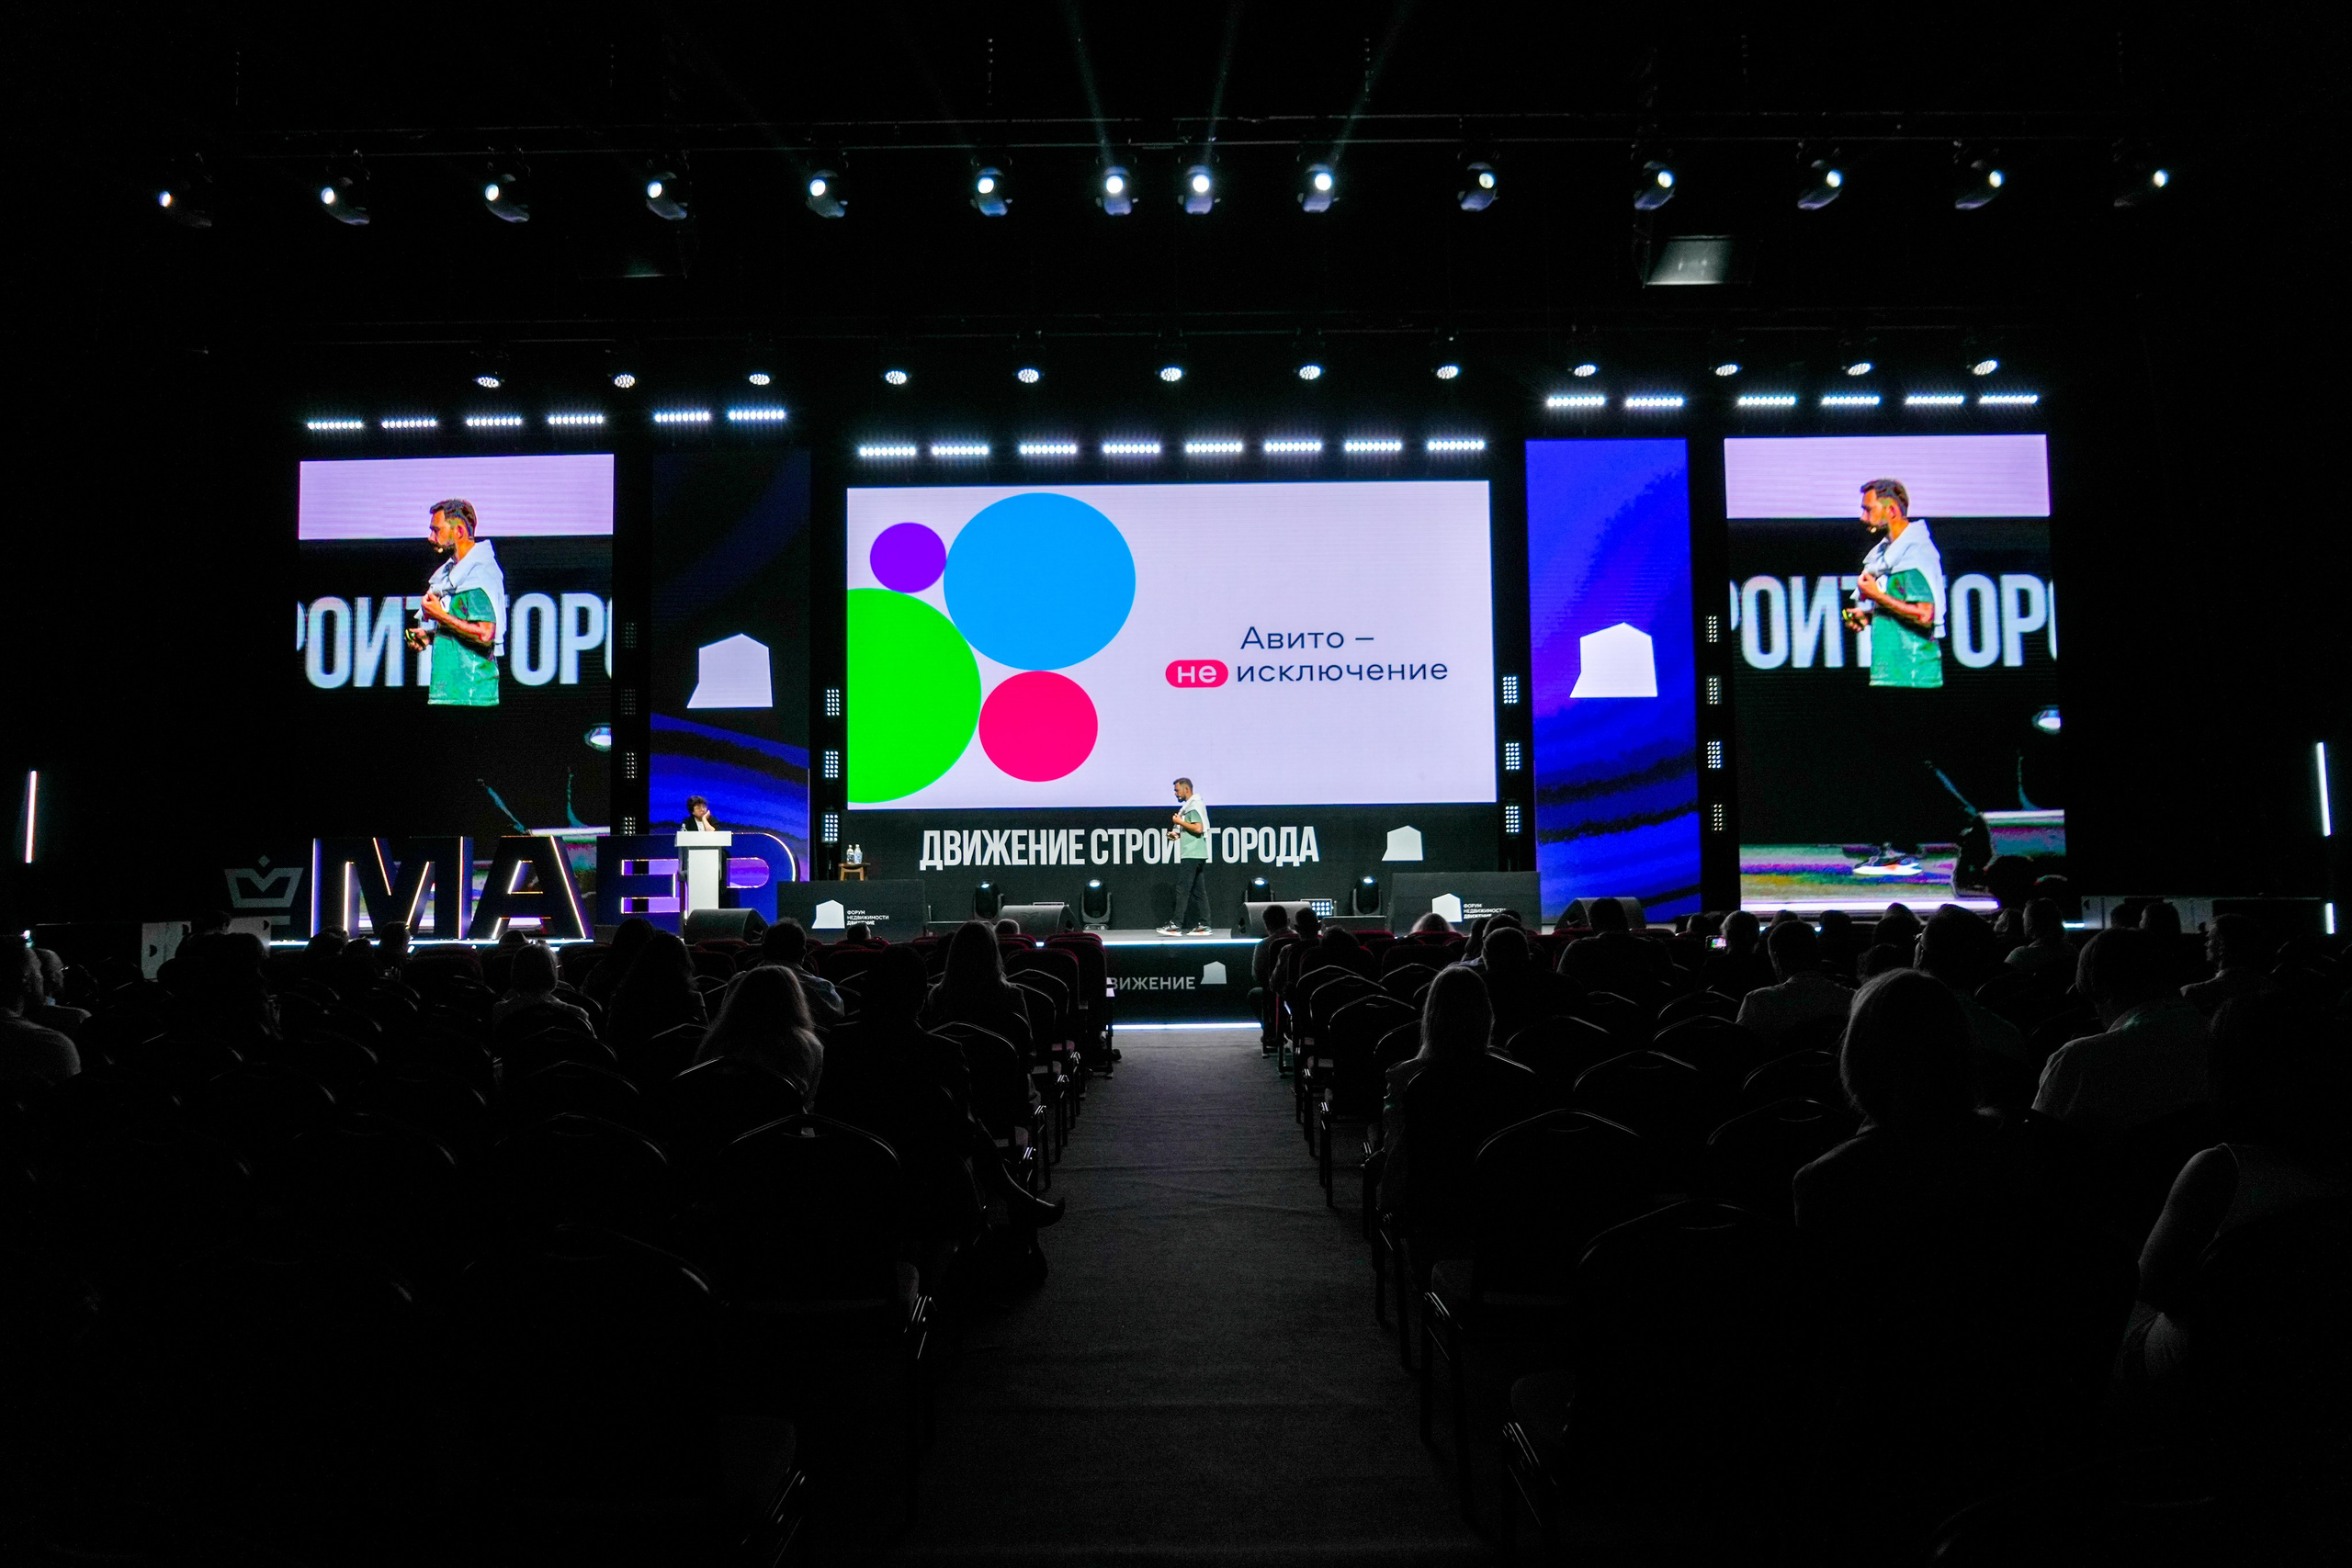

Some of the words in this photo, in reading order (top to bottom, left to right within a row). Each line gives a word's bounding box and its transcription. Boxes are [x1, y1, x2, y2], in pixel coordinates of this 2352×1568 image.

[1239, 626, 1344, 649] Авито
[1177, 665, 1217, 684] не
[1237, 662, 1449, 682] исключение
[919, 829, 1086, 871] ДВИЖЕНИЕ
[1090, 828, 1182, 865] СТРОИ
[1205, 825, 1320, 868] ГОРОДА
[1109, 976, 1196, 990] ВИЖЕНИЕ
